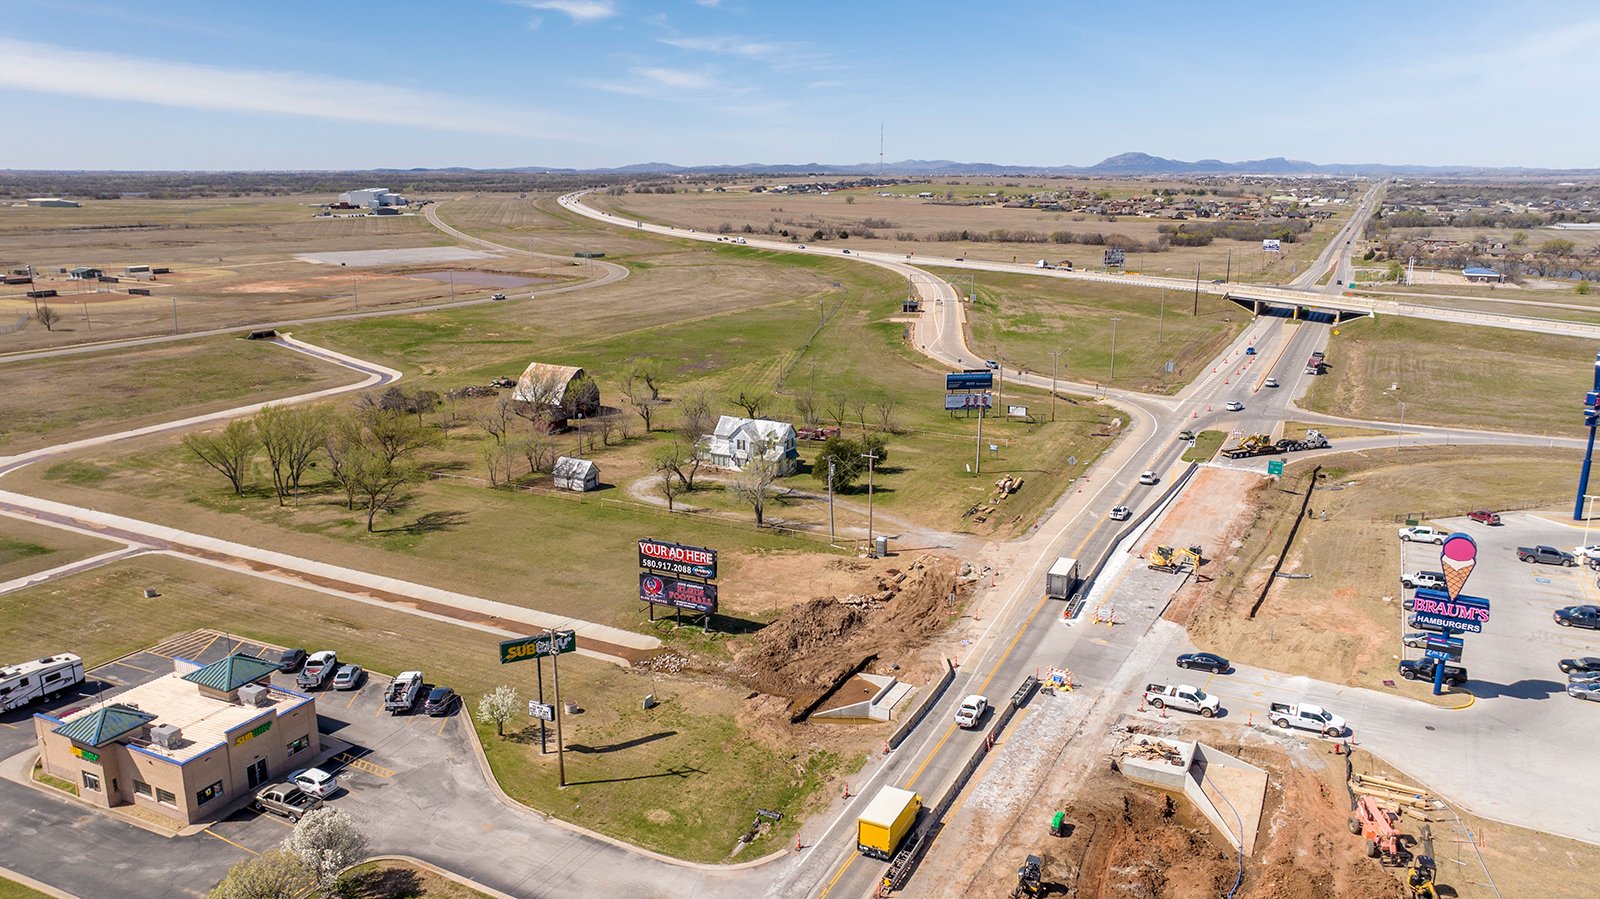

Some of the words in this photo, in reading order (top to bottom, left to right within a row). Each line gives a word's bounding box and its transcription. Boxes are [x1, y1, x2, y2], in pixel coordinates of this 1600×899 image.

[639, 542, 667, 557] YOUR
[669, 547, 684, 559] AD
[686, 550, 713, 564] HERE
[642, 559, 692, 574] 580.917.2088
[668, 591, 713, 607] FOOTBALL
[1413, 598, 1490, 622] BRAUM'S
[1416, 615, 1481, 632] HAMBURGERS
[235, 720, 273, 746] SUBWAY
